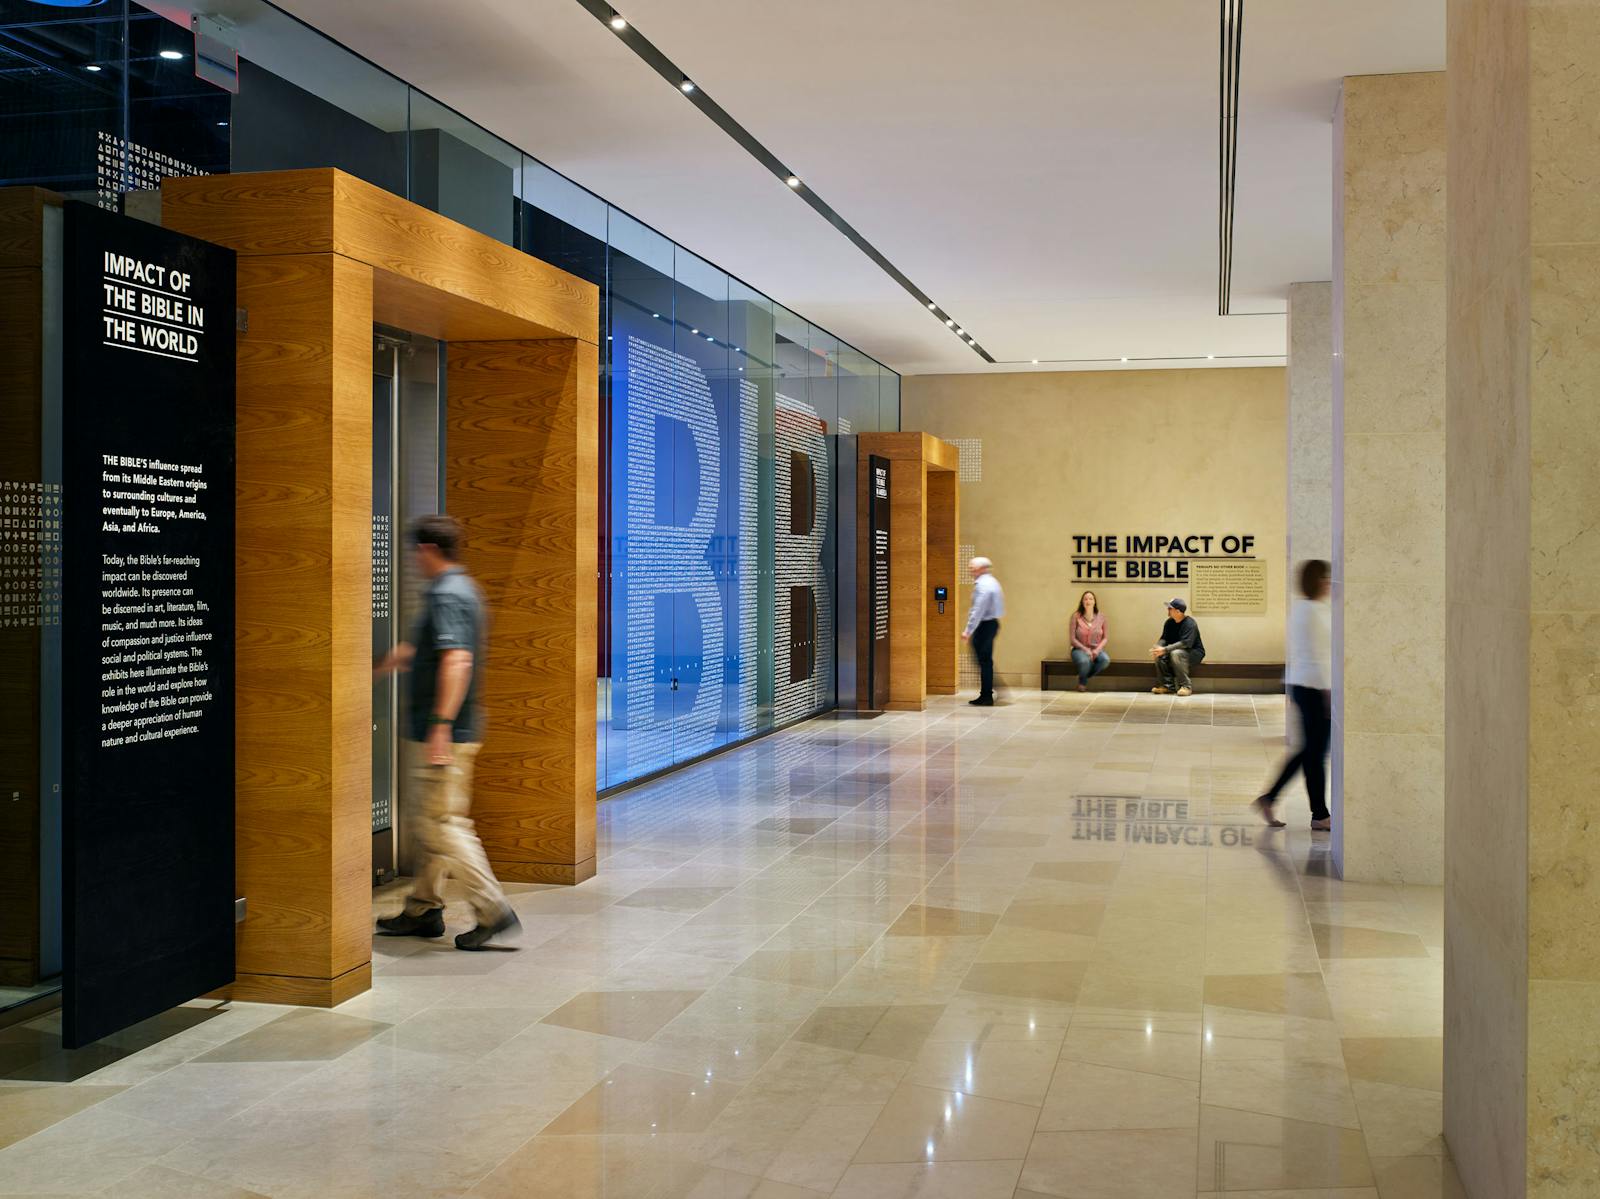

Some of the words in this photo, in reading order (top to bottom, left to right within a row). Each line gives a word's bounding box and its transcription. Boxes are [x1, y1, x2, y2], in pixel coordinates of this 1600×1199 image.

[105, 251, 165, 286] IMPACT
[170, 270, 190, 292] OF
[104, 284, 136, 311] THE
[142, 293, 183, 322] BIBLE
[188, 305, 203, 327] IN
[103, 316, 136, 343] THE
[141, 324, 198, 355] WORLD
[103, 455, 118, 466] THE
[149, 459, 178, 472] influence
[180, 464, 202, 474] spread
[103, 471, 120, 482] from
[122, 473, 131, 483] its
[133, 474, 157, 485] Middle
[159, 476, 184, 487] Eastern
[186, 479, 207, 491] origins
[103, 489, 111, 498] to
[113, 490, 155, 503] surrounding
[157, 492, 183, 502] cultures
[184, 494, 196, 503] and
[103, 506, 140, 518] eventually
[142, 508, 149, 516] to
[151, 507, 177, 520] Europe,
[179, 509, 206, 520] America,
[102, 521, 120, 533] Asia,
[123, 522, 135, 532] and
[138, 522, 160, 533] Africa.
[1072, 536, 1117, 553] THE
[1126, 536, 1213, 553] IMPACT
[1221, 536, 1254, 553] OF
[102, 554, 125, 567] Today,
[127, 554, 138, 564] the
[163, 555, 200, 567] far-reaching
[102, 571, 126, 584] impact
[142, 571, 151, 580] be
[152, 570, 187, 580] discovered
[1072, 561, 1117, 578] THE
[1126, 561, 1188, 578] BIBLE
[102, 587, 140, 597] worldwide.
[142, 587, 150, 596] Its
[152, 589, 181, 600] presence
[182, 588, 193, 596] can
[102, 604, 111, 614] be
[147, 603, 153, 612] in
[155, 605, 165, 613] art,
[167, 602, 195, 612] literature,
[197, 601, 209, 612] film,
[102, 620, 124, 631] music,
[126, 619, 138, 629] and
[140, 618, 157, 629] much
[159, 620, 176, 628] more.
[187, 616, 203, 626] ideas
[102, 636, 110, 647] of
[111, 635, 150, 649] compassion
[151, 633, 163, 644] and
[165, 633, 184, 646] justice
[186, 631, 212, 642] influence
[102, 653, 121, 664] social
[123, 651, 136, 662] and
[137, 649, 162, 664] political
[164, 650, 189, 661] systems.
[191, 647, 202, 657] The
[102, 669, 128, 680] exhibits
[130, 668, 144, 678] here
[146, 666, 176, 676] illuminate
[178, 664, 188, 673] the
[102, 686, 115, 697] role
[117, 686, 123, 696] in
[125, 685, 136, 695] the
[138, 682, 155, 693] world
[157, 680, 169, 691] and
[170, 678, 193, 692] explore
[195, 677, 207, 686] how
[102, 701, 139, 714] knowledge
[140, 698, 147, 708] of
[149, 698, 159, 708] the
[161, 695, 176, 706] Bible
[178, 696, 189, 704] can
[190, 691, 212, 705] provide
[102, 722, 106, 730] a
[108, 719, 132, 731] deeper
[134, 713, 173, 729] appreciation
[175, 710, 181, 720] of
[182, 709, 202, 718] human
[102, 737, 123, 747] nature
[125, 732, 138, 743] and
[139, 728, 162, 742] cultural
[164, 726, 199, 739] experience.
